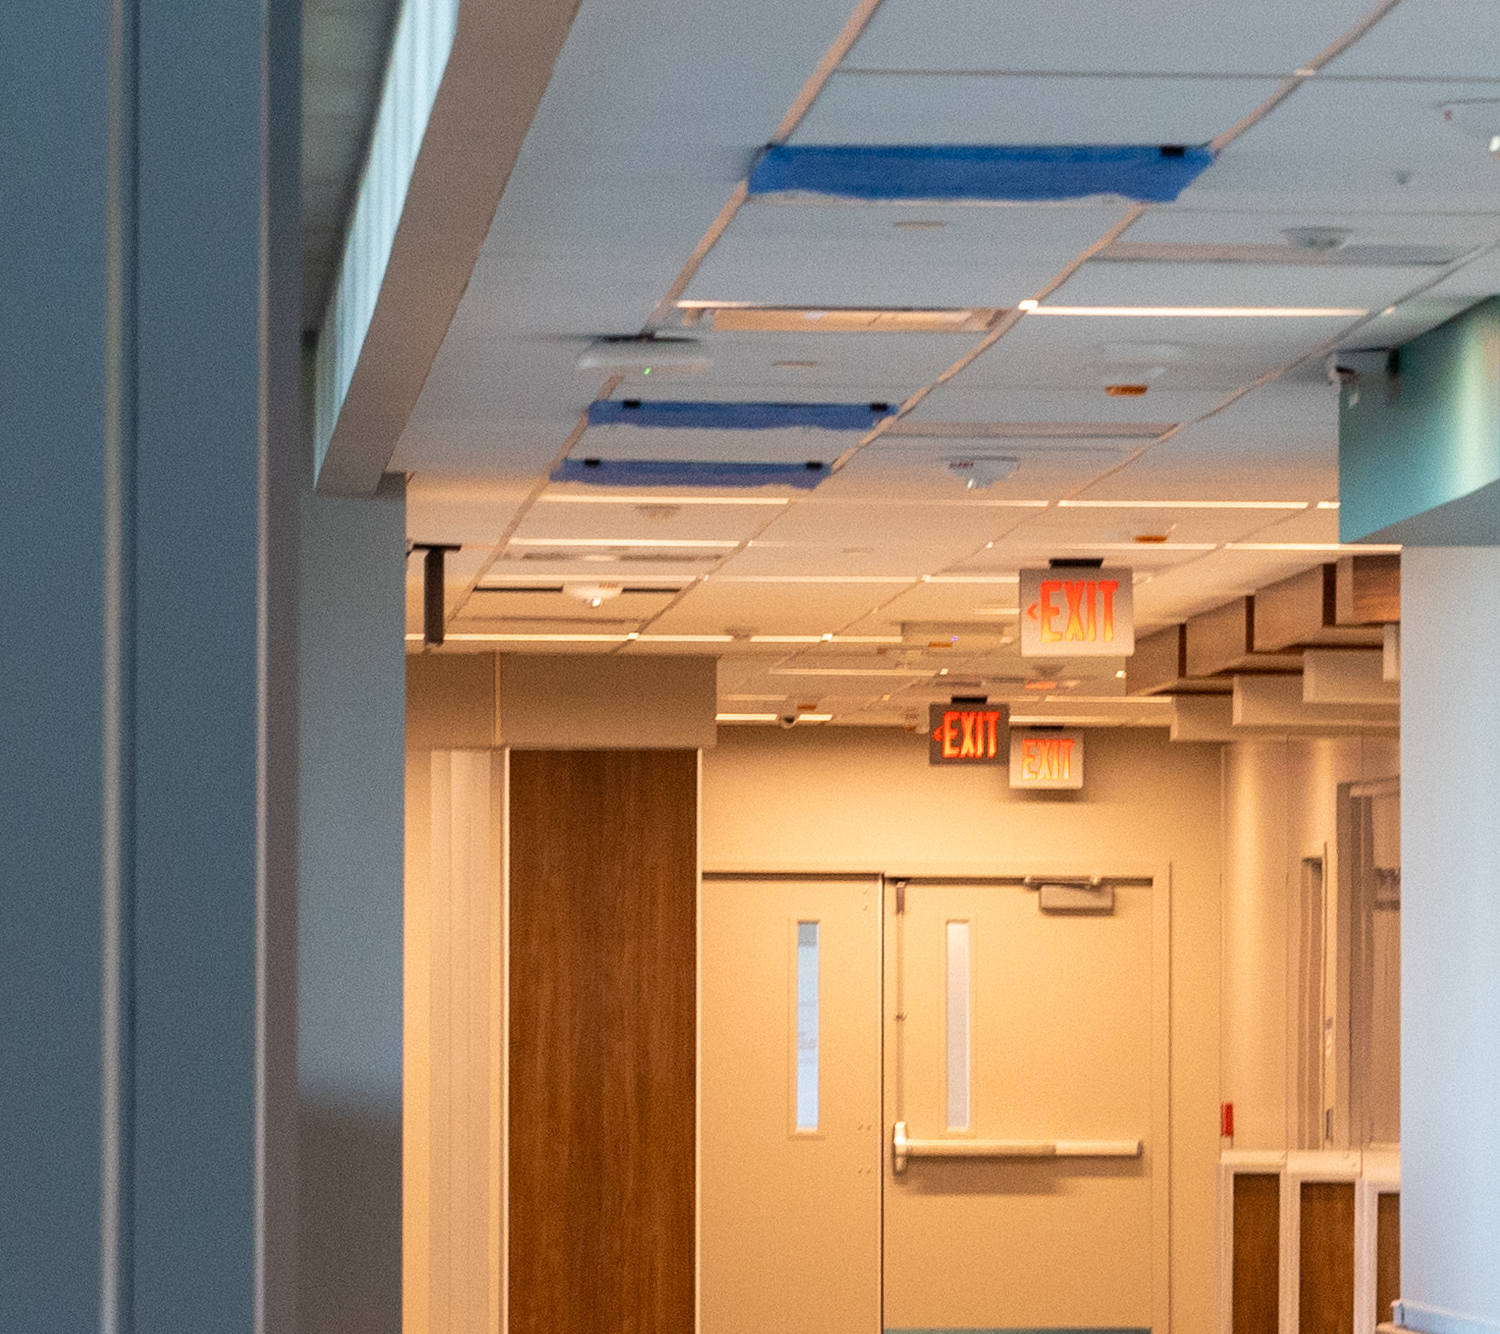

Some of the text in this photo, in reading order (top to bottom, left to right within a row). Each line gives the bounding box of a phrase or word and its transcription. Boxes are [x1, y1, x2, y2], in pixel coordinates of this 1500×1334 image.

[1040, 579, 1119, 643] EXIT
[942, 711, 1000, 759] EXIT
[1022, 739, 1075, 780] EXIT
